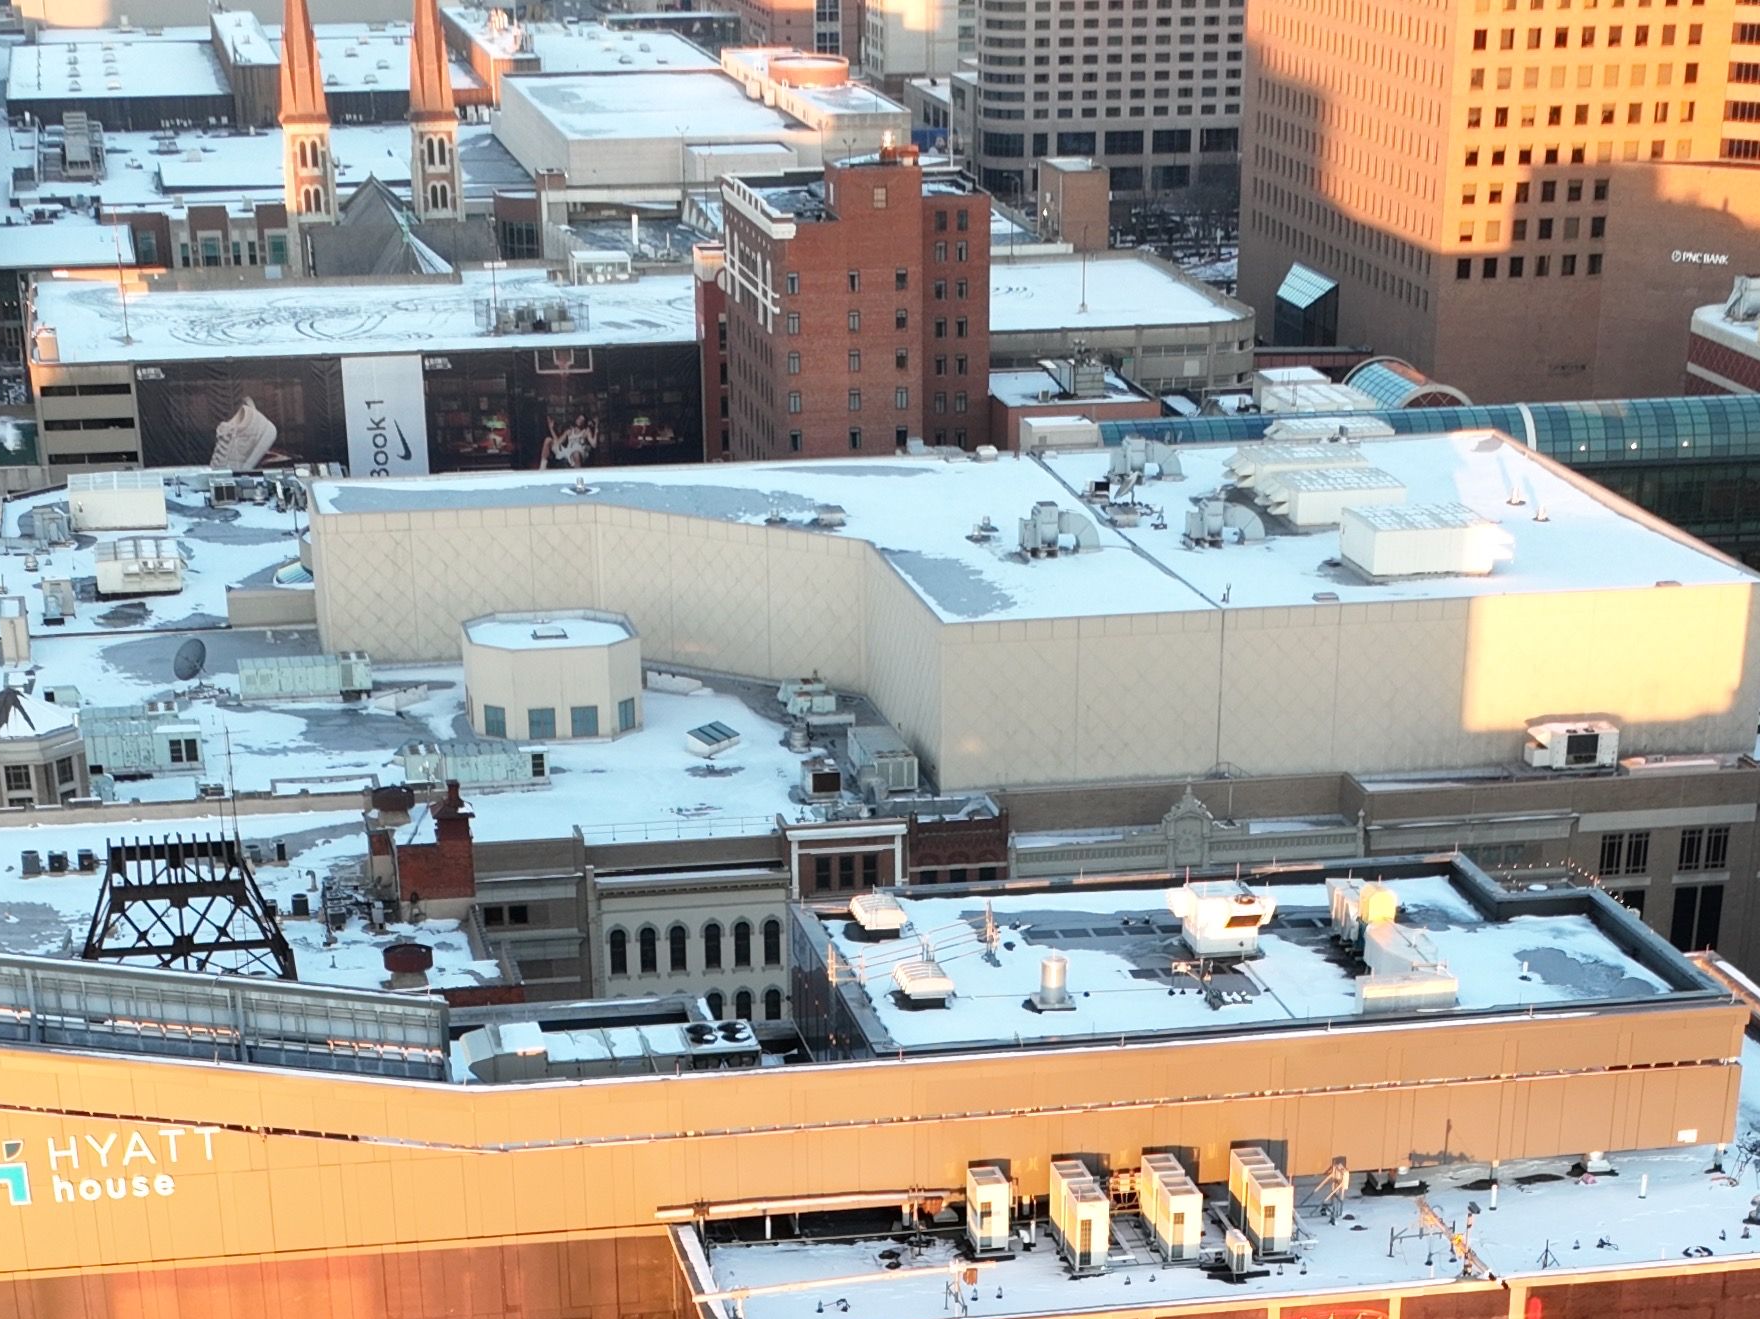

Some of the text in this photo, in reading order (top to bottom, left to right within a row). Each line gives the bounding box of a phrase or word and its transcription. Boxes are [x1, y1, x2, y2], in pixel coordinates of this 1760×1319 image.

[1682, 252, 1729, 265] PNC BANK
[41, 1127, 220, 1172] HYATT
[52, 1173, 176, 1203] house
